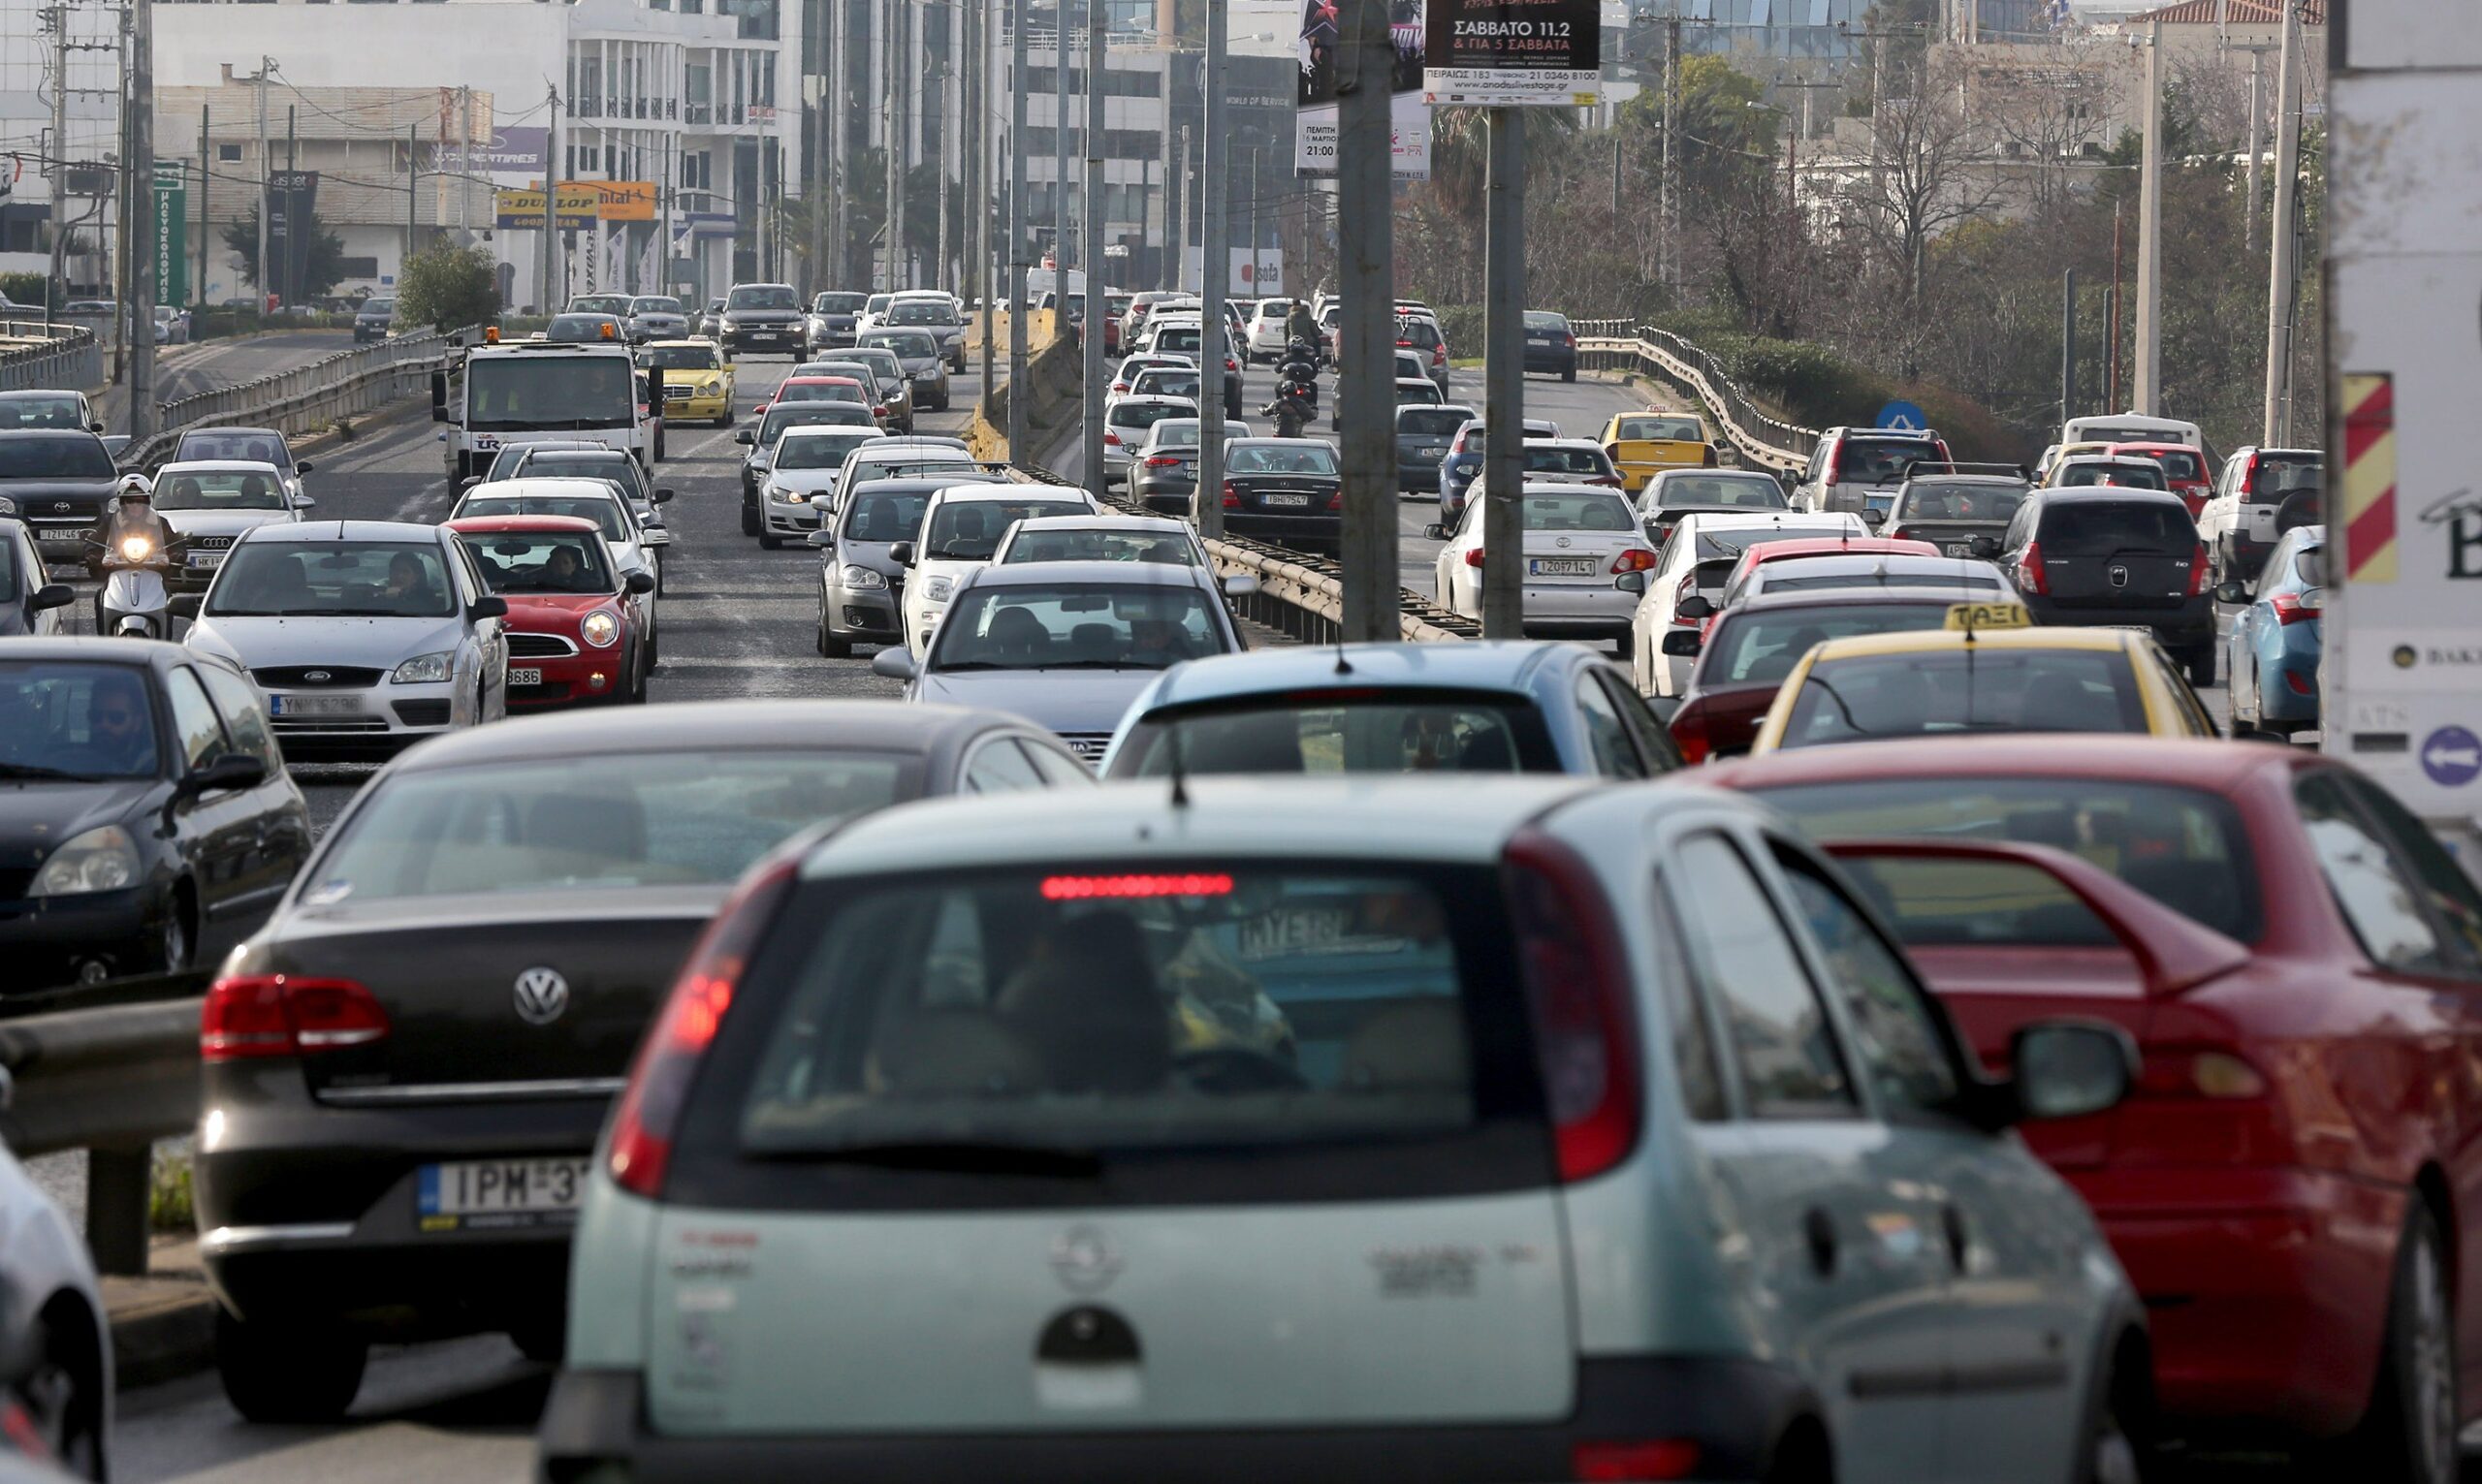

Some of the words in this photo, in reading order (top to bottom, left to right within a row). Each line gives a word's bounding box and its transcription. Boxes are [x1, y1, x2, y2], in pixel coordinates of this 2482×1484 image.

[1453, 21, 1533, 36] ΣΑΒΒΑΤΟ
[1540, 21, 1571, 37] 11.2
[1453, 39, 1464, 48] &
[1469, 39, 1490, 49] ΓΙΑ
[1496, 39, 1503, 49] 5
[1508, 39, 1571, 50] ΣΑΒΒΑΤΑ
[1426, 69, 1469, 79] ΠΕΙΡΑΙΩΣ
[1473, 71, 1490, 79] 183
[1529, 71, 1543, 80] 21
[1545, 72, 1569, 80] 0346
[1573, 72, 1597, 81] 8100
[1306, 145, 1334, 156] 21:00
[515, 199, 593, 208] DULOP
[513, 218, 581, 228] GOODEAR
